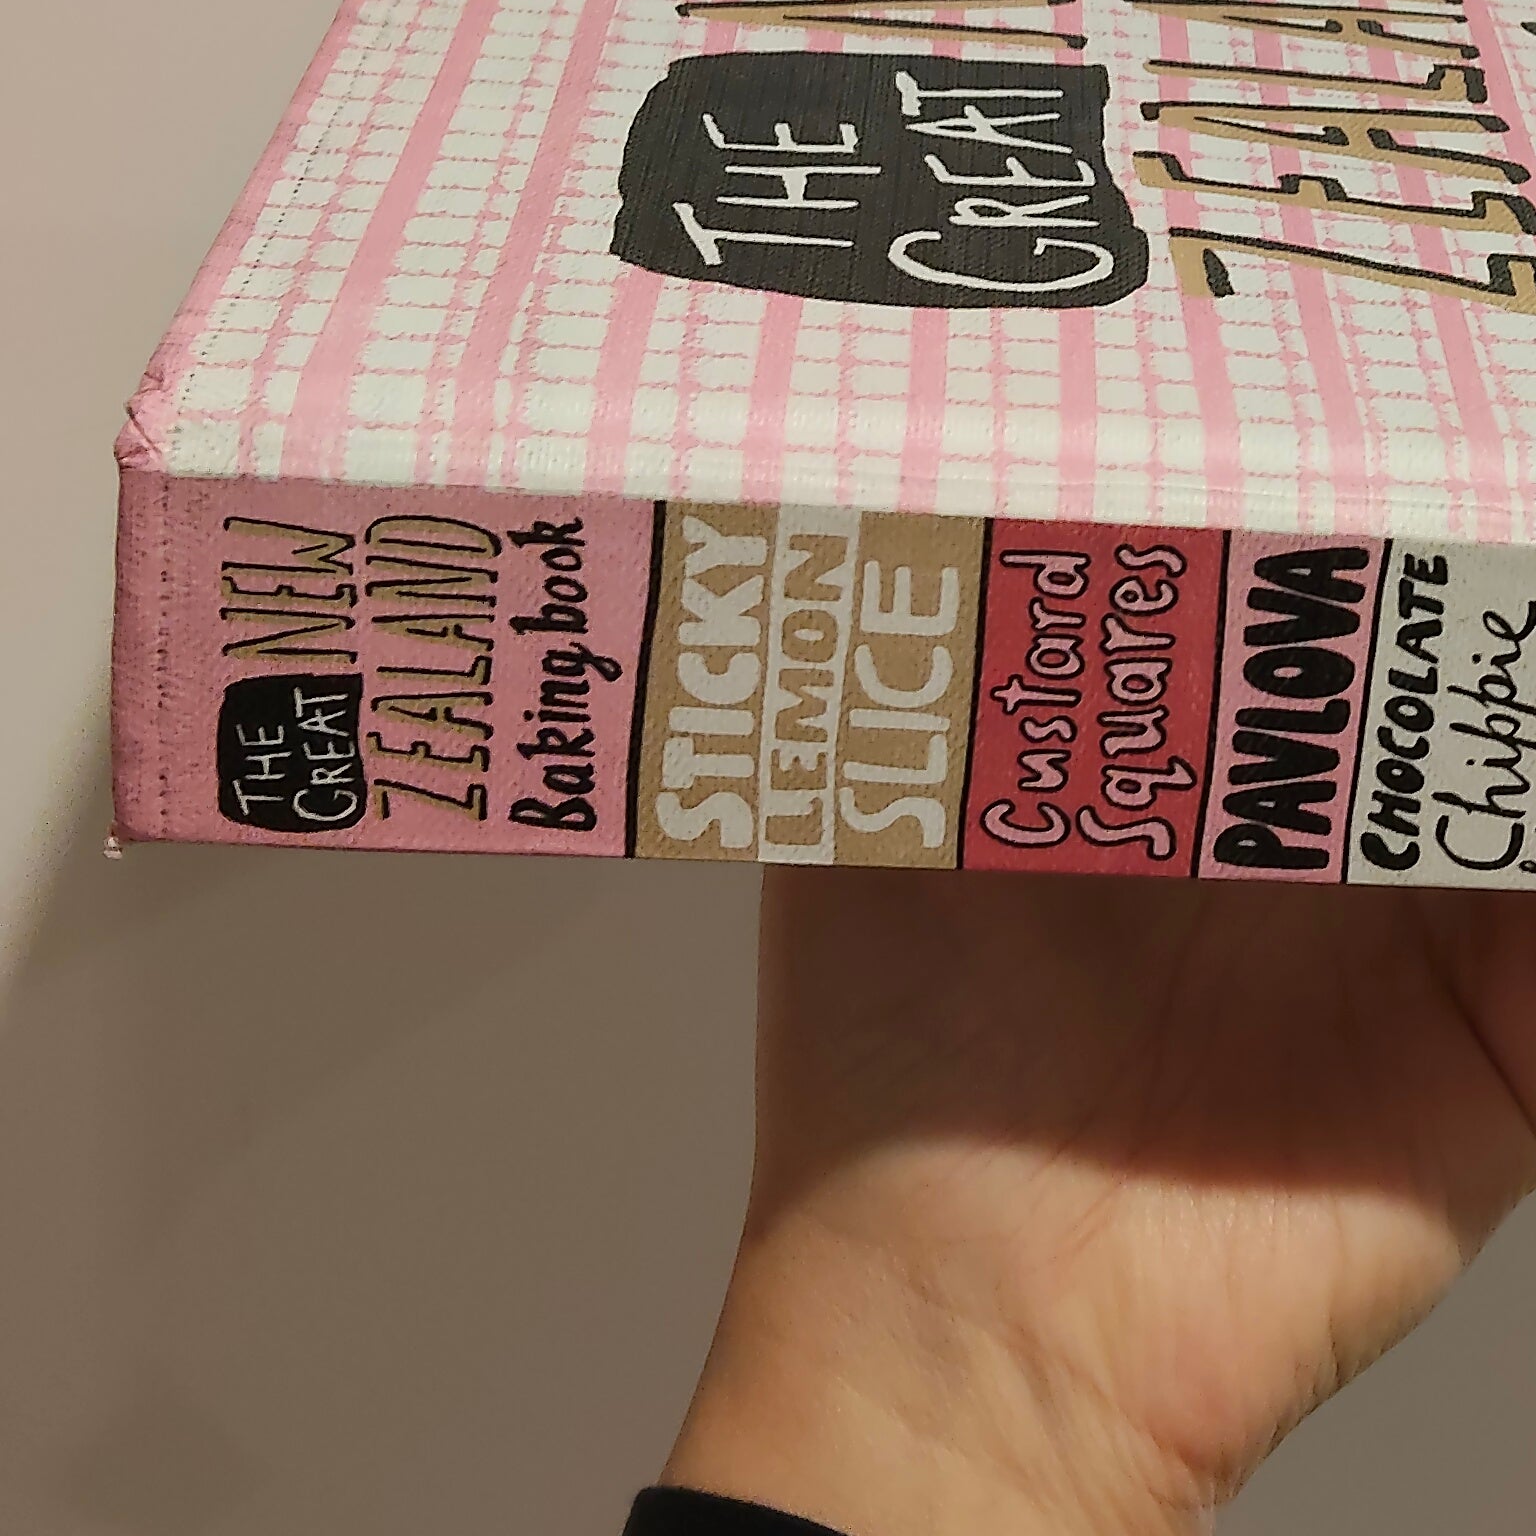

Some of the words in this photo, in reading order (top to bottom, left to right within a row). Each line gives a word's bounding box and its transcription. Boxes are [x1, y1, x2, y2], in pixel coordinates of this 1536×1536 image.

[673, 114, 882, 265] THE
[888, 70, 1115, 293] GREAT
[219, 516, 358, 664] NEW
[364, 514, 503, 821] ZEALAND
[506, 516, 589, 635] book
[655, 515, 768, 850] STICKY
[763, 534, 850, 848] LEMON
[839, 560, 960, 849] SLICE
[978, 548, 1091, 849] Custard
[1076, 543, 1197, 861] Squares
[1213, 546, 1371, 870] PAVLOVA
[1360, 552, 1449, 871] CHOCOLATE
[232, 722, 292, 816] THE
[292, 686, 358, 823] GREAT
[507, 641, 625, 832] Baking
